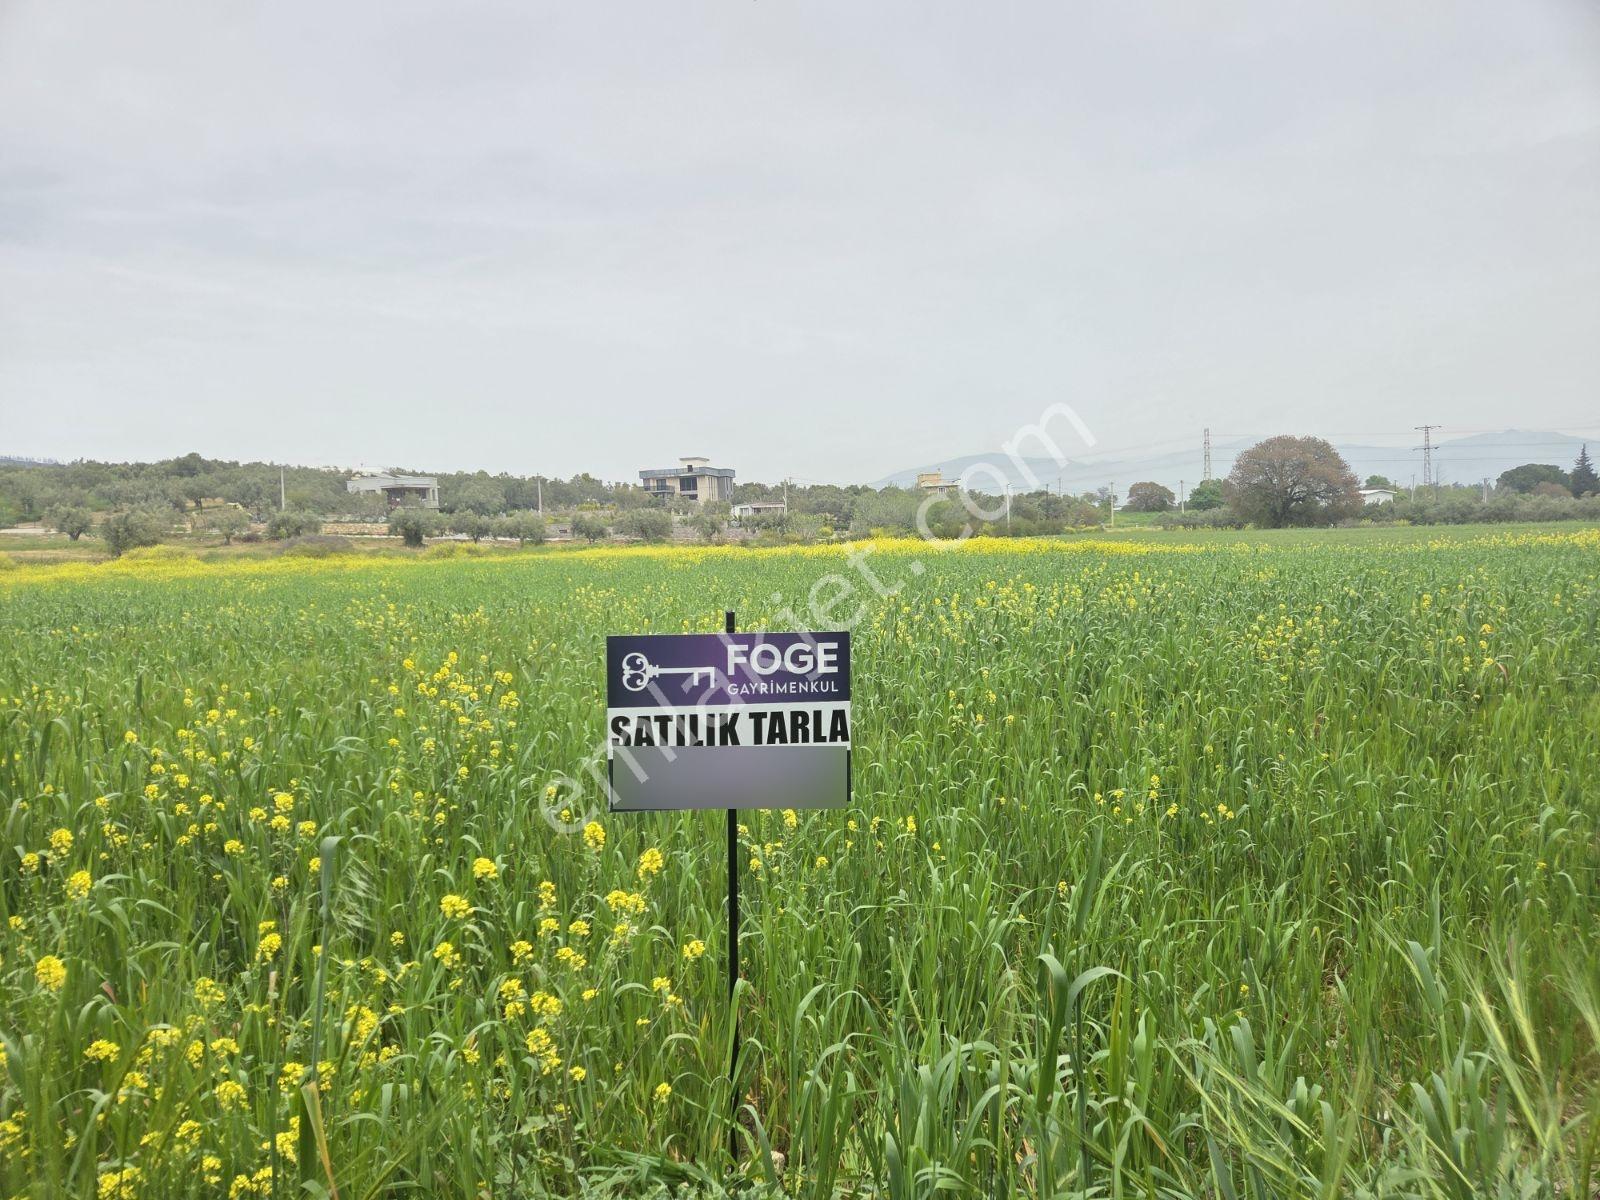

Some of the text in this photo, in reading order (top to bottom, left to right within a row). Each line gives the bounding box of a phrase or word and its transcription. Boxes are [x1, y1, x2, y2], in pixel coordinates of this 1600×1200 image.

[727, 642, 839, 676] FOGE
[727, 680, 839, 695] GAYRİMENKUL
[610, 709, 850, 747] SATILIK TARLA
